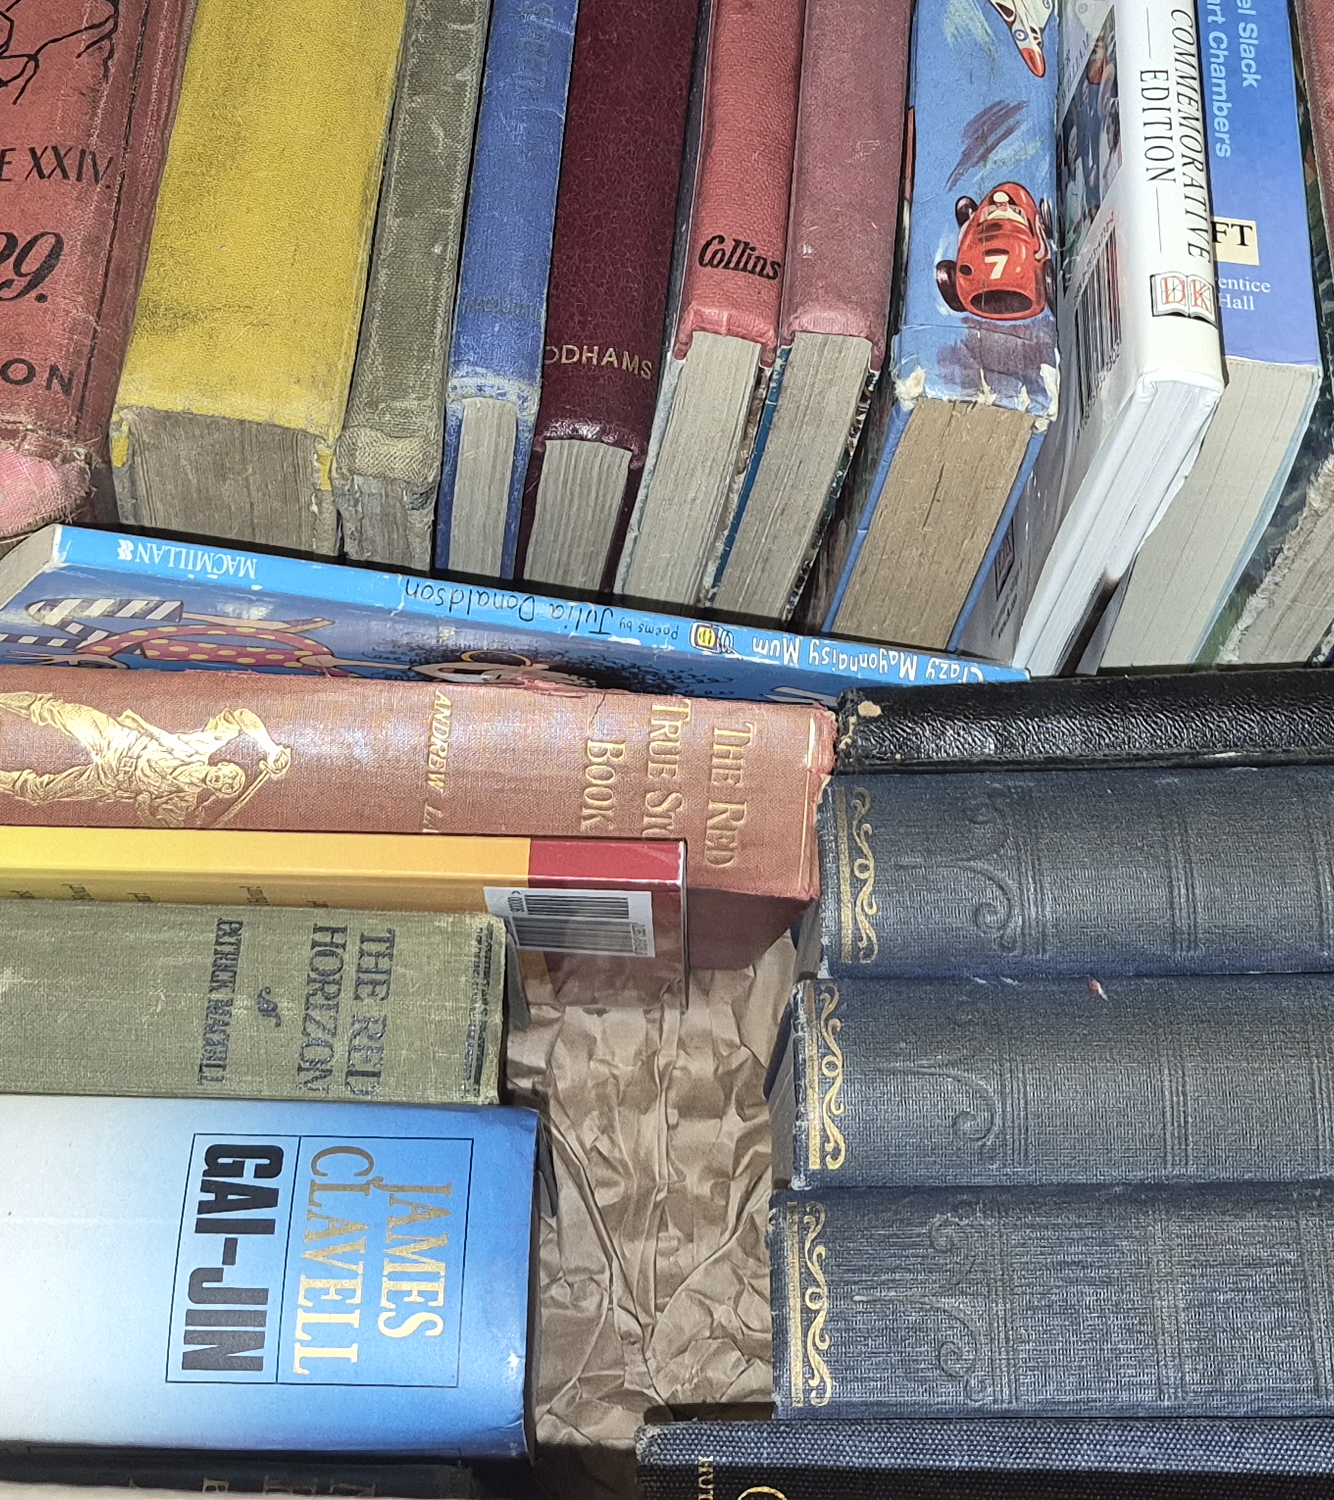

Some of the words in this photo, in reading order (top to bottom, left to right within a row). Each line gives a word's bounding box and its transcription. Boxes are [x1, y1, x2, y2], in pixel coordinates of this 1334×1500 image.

[1236, 16, 1261, 89] Slack
[1139, 68, 1178, 183] EDITION
[1209, 31, 1232, 159] Chambers
[1170, 8, 1212, 264] COMMEMORATIVE
[698, 234, 783, 281] Collins
[983, 254, 1009, 280] 7
[1211, 220, 1254, 249] FT
[1160, 272, 1215, 316] DK
[543, 344, 653, 380] ODHAMS
[135, 542, 257, 579] MACMILLAN
[405, 578, 537, 623] Donaldson
[548, 602, 615, 637] Julia
[620, 614, 635, 632] by
[638, 617, 679, 641] poems
[753, 636, 800, 666] Mum
[425, 689, 453, 794] ANDREW
[647, 699, 694, 781] TRUE
[711, 721, 757, 788] THE
[580, 738, 626, 835] BOOK
[705, 800, 748, 868] RED
[352, 928, 397, 1002] THE
[296, 923, 349, 1095] HORIZON
[346, 1014, 388, 1097] RED
[182, 1141, 286, 1375] GAI-JIN
[294, 1144, 377, 1378] CLAVELL
[373, 1177, 454, 1342] JAMES
